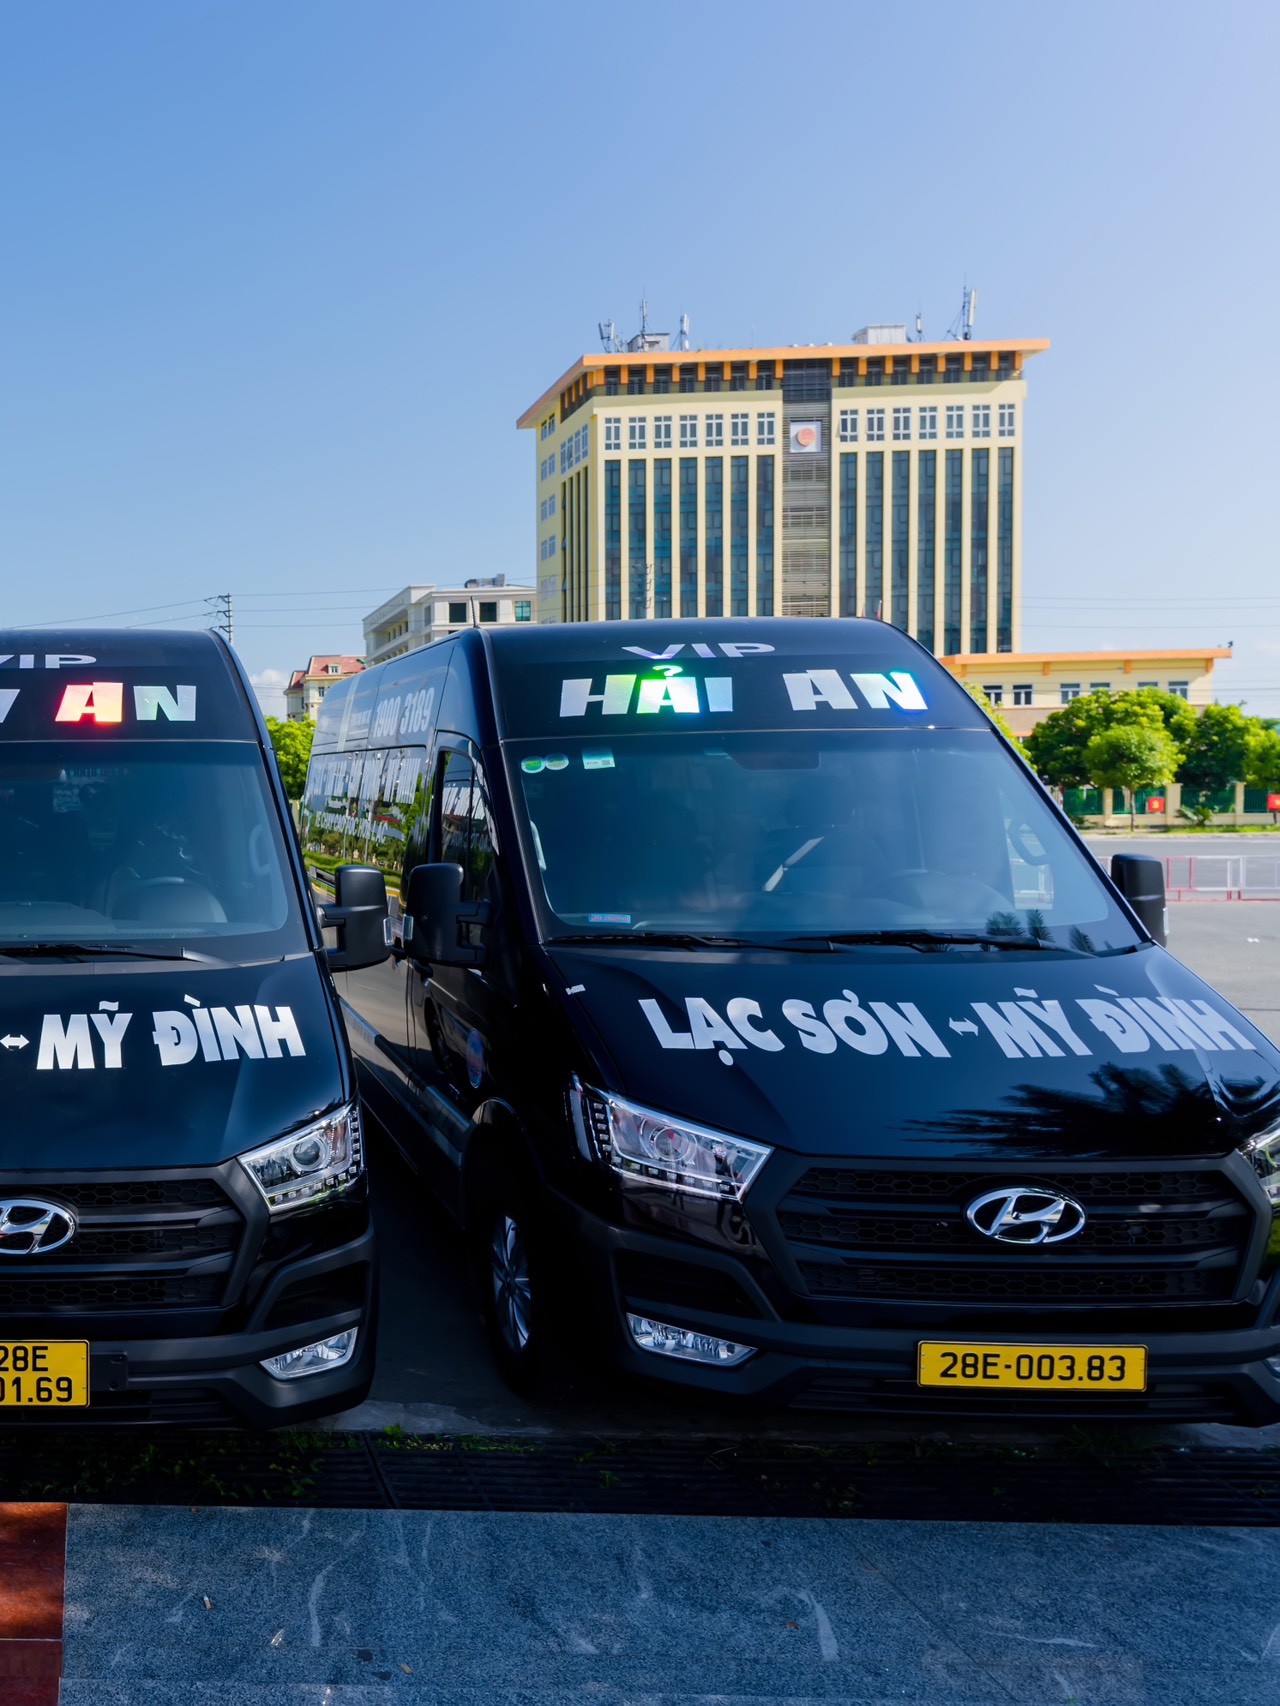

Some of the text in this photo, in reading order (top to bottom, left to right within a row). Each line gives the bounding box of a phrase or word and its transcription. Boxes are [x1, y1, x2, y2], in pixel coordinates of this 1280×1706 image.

[622, 642, 775, 660] VIP
[55, 682, 197, 722] AN
[400, 687, 435, 735] 3189
[559, 665, 929, 717] HẢI AN
[36, 1001, 133, 1070] MỸ
[152, 994, 306, 1066] ĐÌNH
[638, 984, 1257, 1067] LẠC SƠN MỸ ĐÌNH
[939, 1352, 1126, 1381] 28E-003.83
